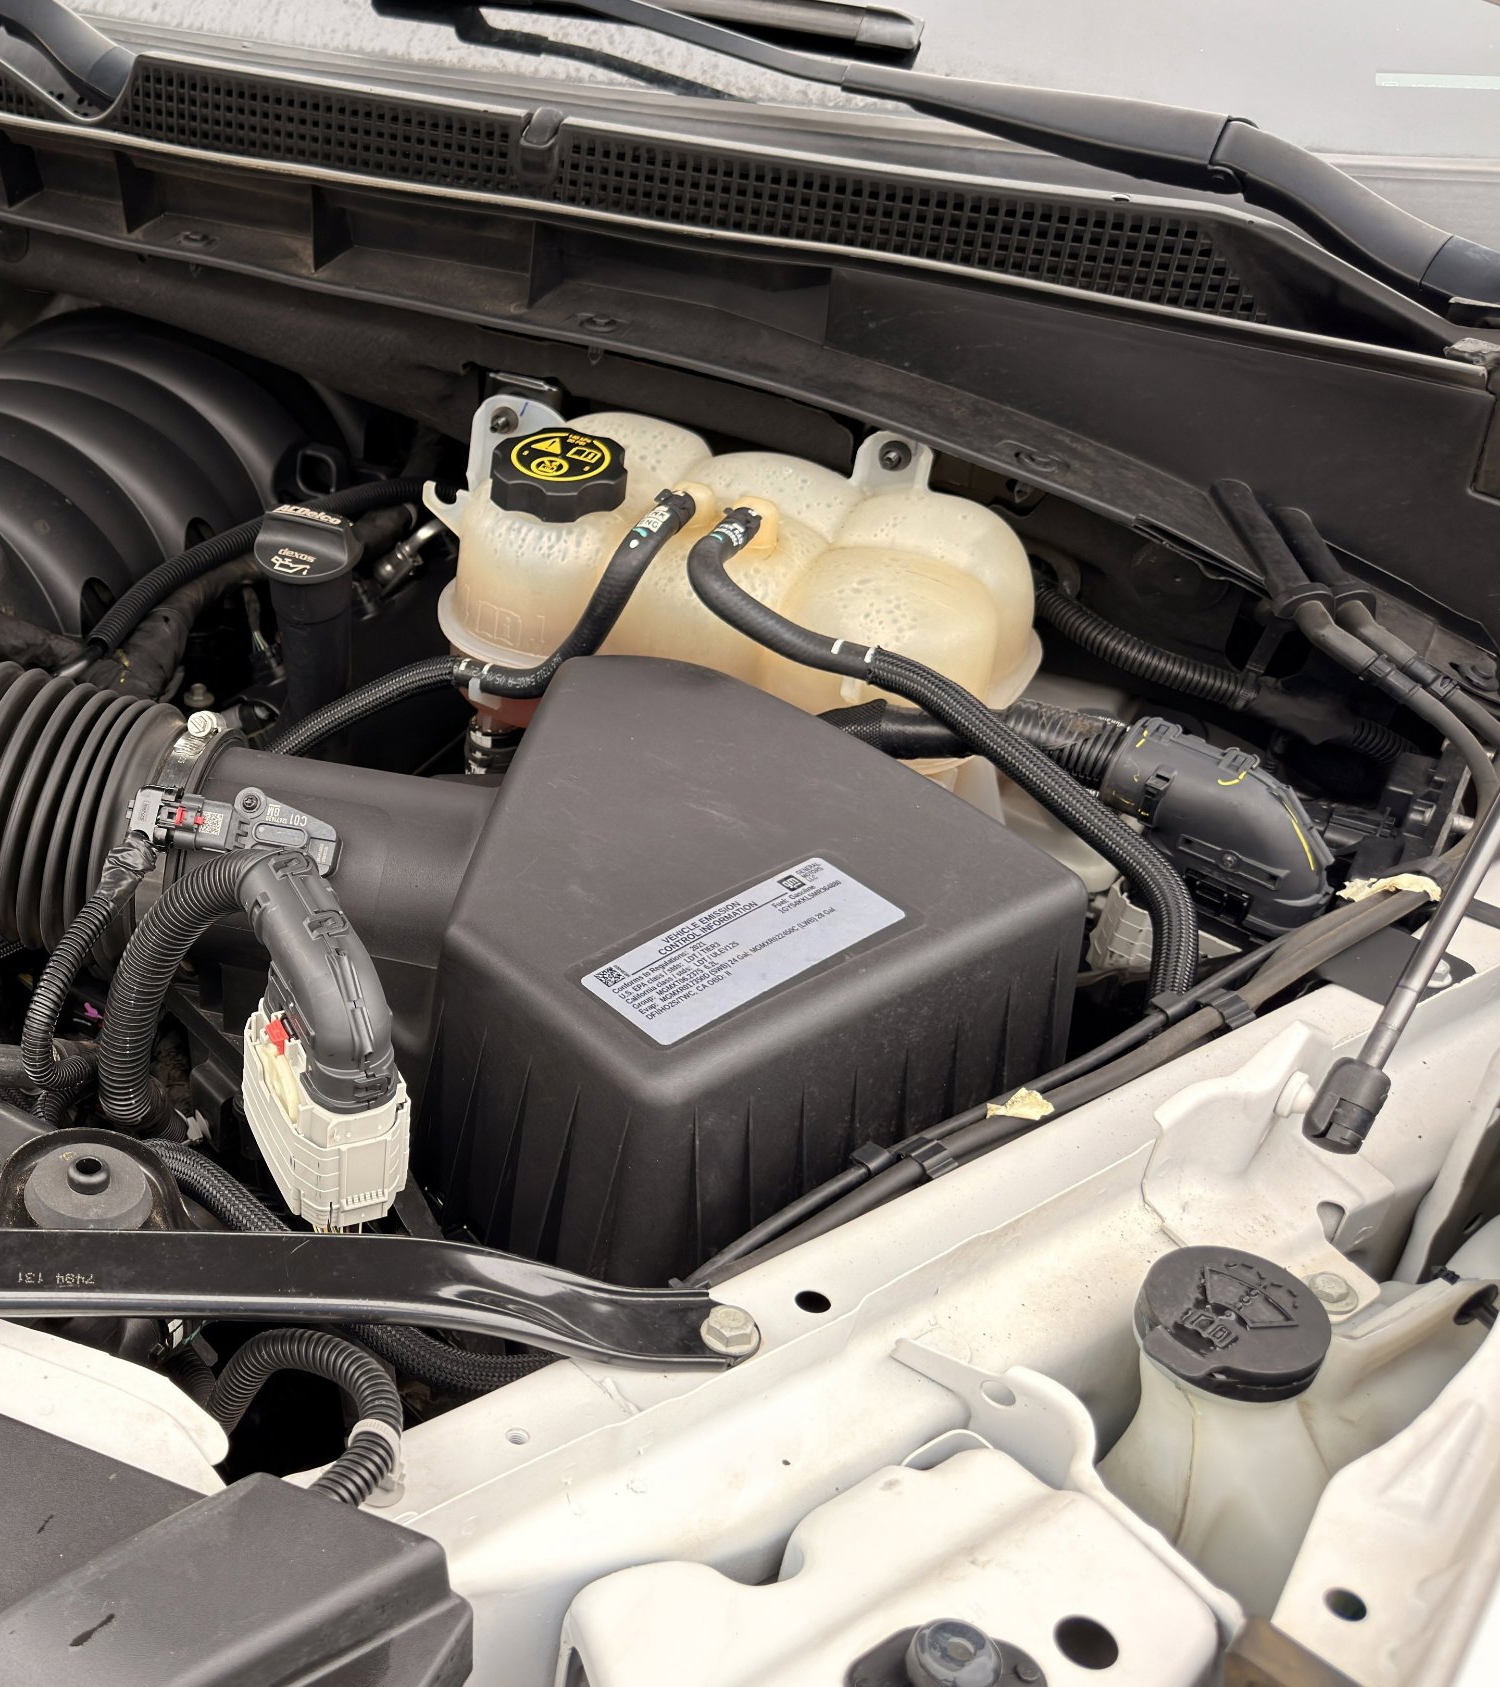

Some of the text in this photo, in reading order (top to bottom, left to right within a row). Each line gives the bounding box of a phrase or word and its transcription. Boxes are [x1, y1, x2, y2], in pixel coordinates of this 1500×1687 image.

[272, 504, 341, 525] ACDelco
[278, 548, 317, 563] dexos
[267, 803, 280, 817] GM
[289, 813, 307, 827] C01
[789, 886, 816, 900] Gasoline
[659, 901, 758, 955] CONTROL INFORMATION
[662, 902, 741, 943] VEHICLE EMISSION
[612, 976, 644, 994] Conforms
[649, 951, 689, 973] Regulations:
[690, 942, 707, 952] 2021
[632, 983, 648, 992] EPA
[647, 974, 665, 984] class
[684, 953, 699, 963] LDT
[700, 942, 721, 954] TIER3
[639, 1003, 659, 1015] Evap:
[823, 907, 836, 915] Gal
[626, 986, 657, 1004] California
[657, 977, 674, 988] class
[693, 957, 708, 967] LDT
[710, 941, 739, 958] ULEV125
[696, 984, 709, 992] CA
[632, 996, 656, 1009] Group:
[18, 1272, 43, 1283] 131
